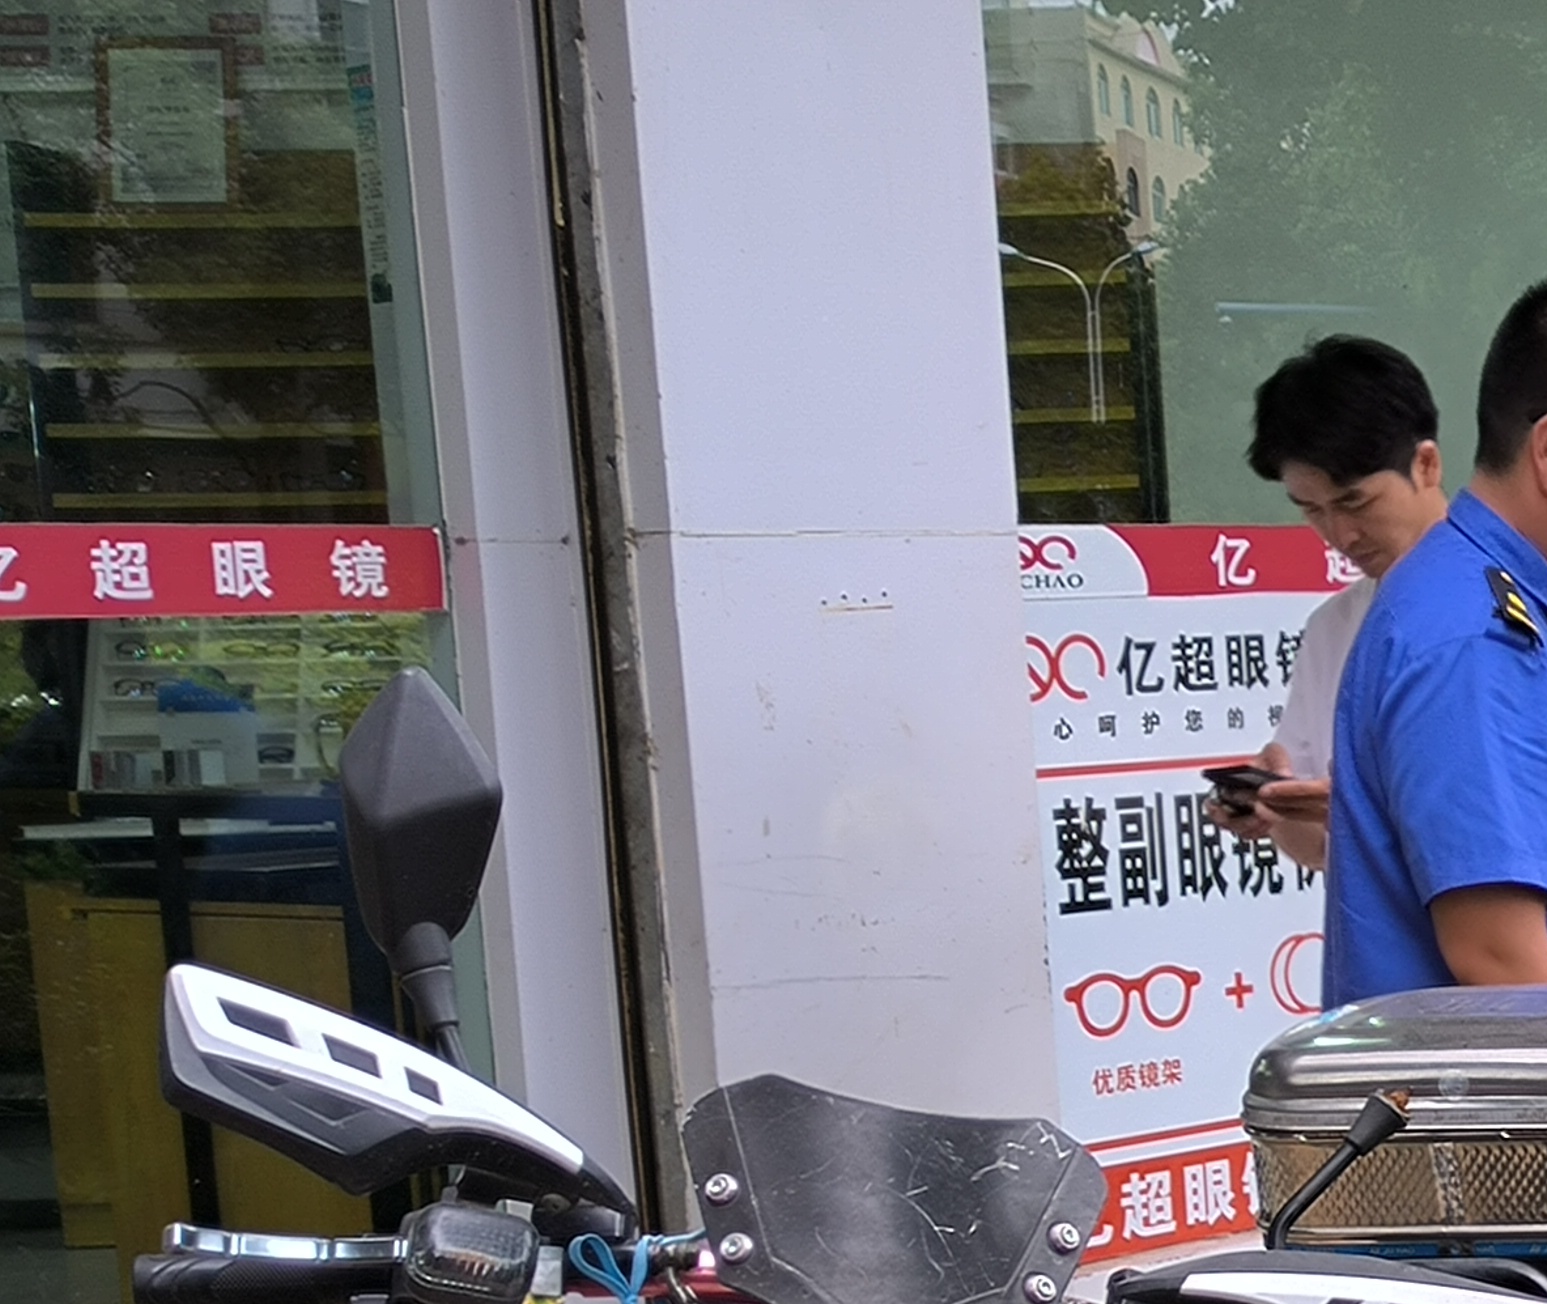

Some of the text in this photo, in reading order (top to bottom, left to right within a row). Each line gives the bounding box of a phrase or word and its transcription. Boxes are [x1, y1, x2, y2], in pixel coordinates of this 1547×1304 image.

[1052, 792, 1324, 916] 整副眼镜
[1092, 1059, 1184, 1096] 优质镜架
[1086, 1151, 1260, 1249] 超眼
